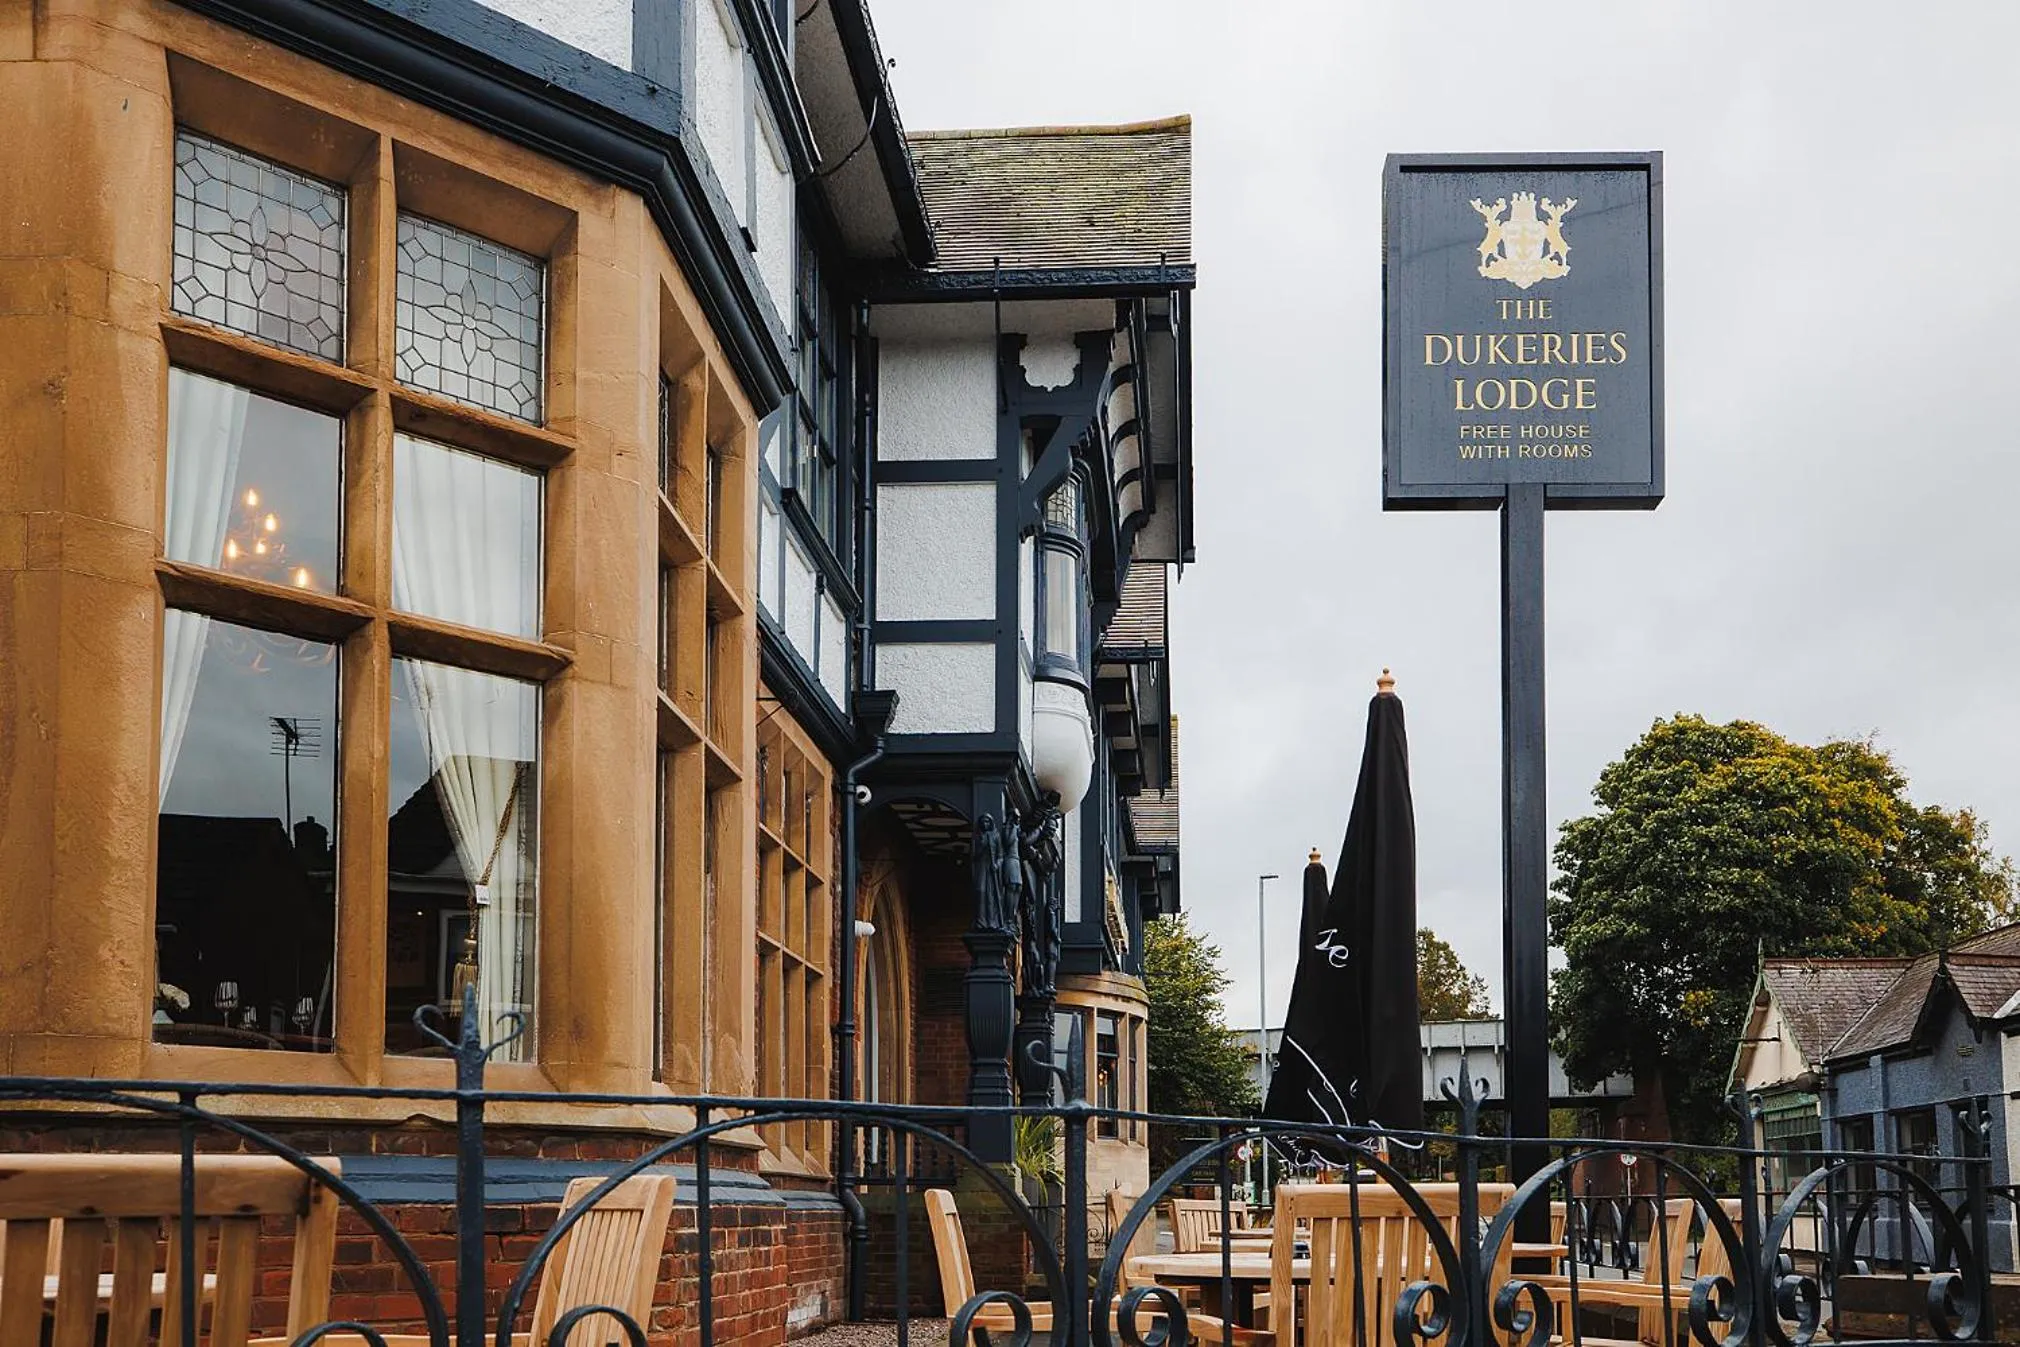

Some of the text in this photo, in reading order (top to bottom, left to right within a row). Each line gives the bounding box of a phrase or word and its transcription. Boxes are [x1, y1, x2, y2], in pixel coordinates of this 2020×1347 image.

[1496, 299, 1553, 320] THE
[1423, 332, 1628, 366] DUKERIES
[1454, 378, 1598, 411] LODGE
[1459, 425, 1591, 439] FREE HOUSE
[1459, 443, 1593, 459] WITH ROOMS
